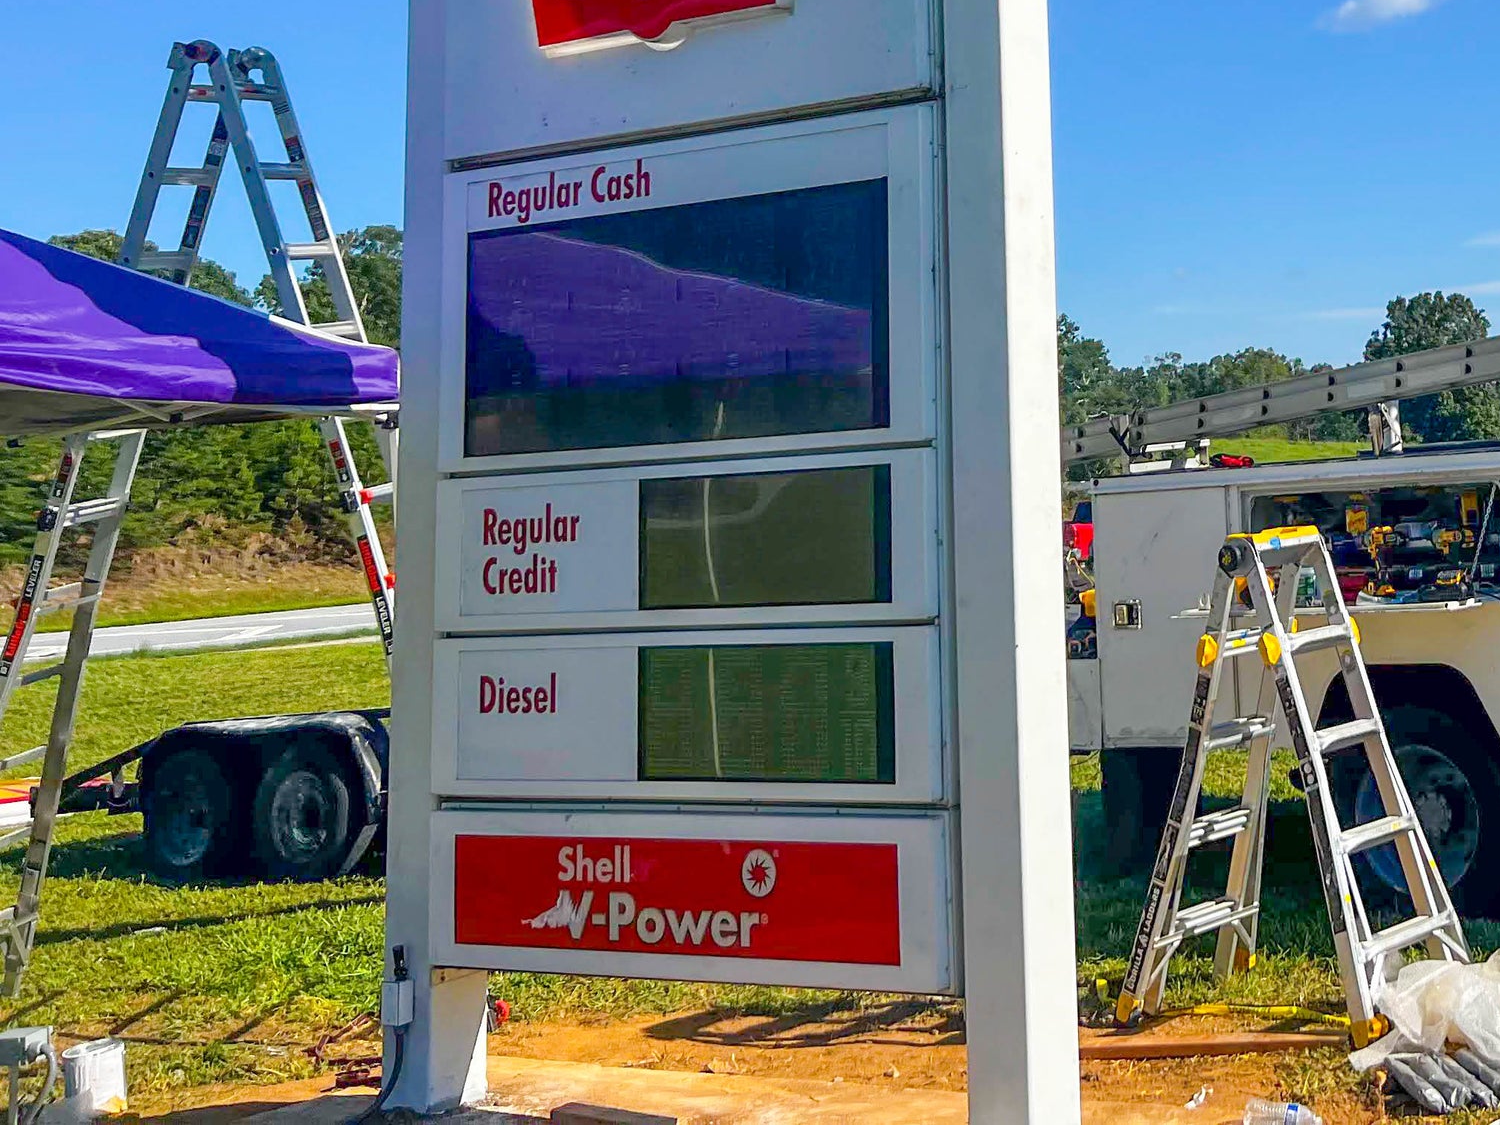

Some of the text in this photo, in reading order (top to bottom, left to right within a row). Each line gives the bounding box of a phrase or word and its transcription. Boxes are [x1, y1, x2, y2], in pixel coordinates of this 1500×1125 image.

[488, 159, 651, 224] Regular Cash
[483, 503, 580, 555] Regular
[25, 559, 42, 598] LEVELER
[483, 556, 558, 595] Credit
[375, 596, 391, 635] LEVELER
[480, 672, 557, 714] Diesel
[558, 844, 631, 883] Shell
[545, 889, 761, 948] V-Power
[1143, 887, 1160, 934] LADDERS
